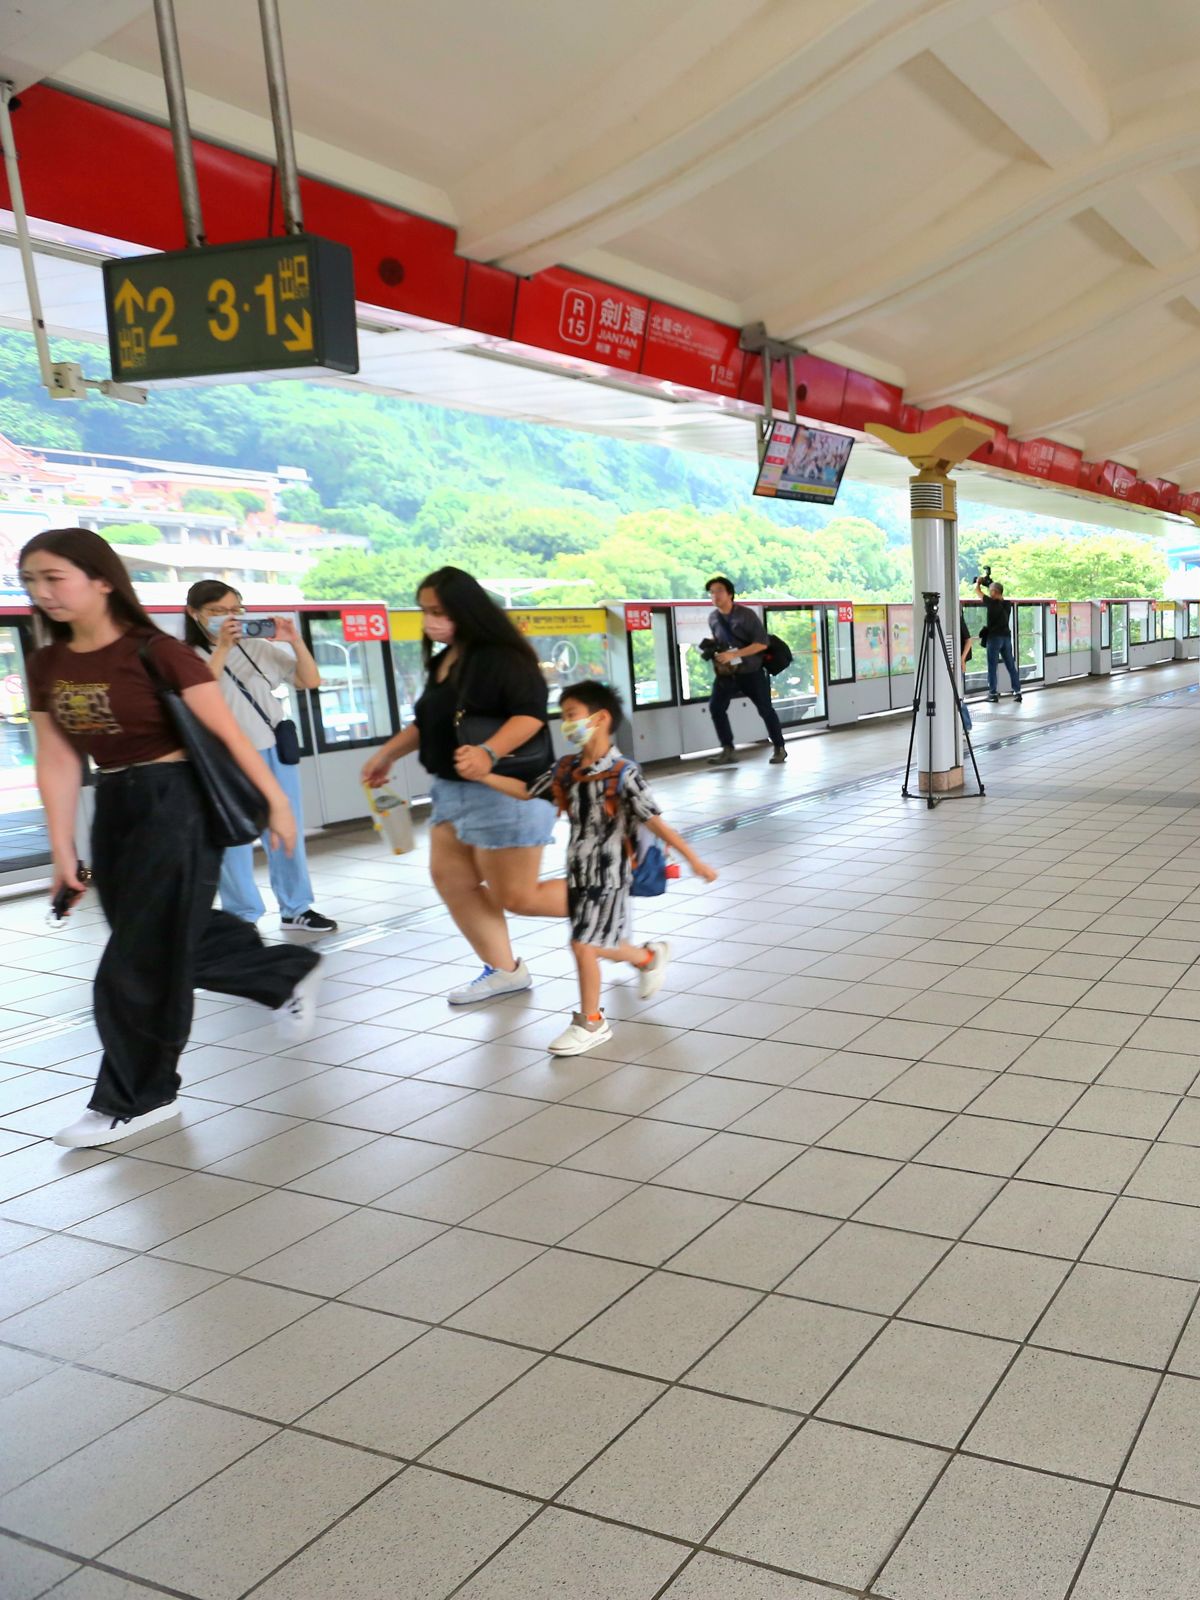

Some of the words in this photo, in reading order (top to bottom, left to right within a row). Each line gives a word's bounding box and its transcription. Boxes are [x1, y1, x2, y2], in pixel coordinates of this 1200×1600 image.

[278, 255, 309, 301] 出口
[147, 286, 178, 349] 2
[573, 298, 585, 317] R
[599, 297, 646, 337] 劍潭
[567, 317, 585, 337] 15
[597, 328, 638, 349] JIANTAN
[118, 326, 146, 369] 出口
[369, 614, 386, 637] 3
[640, 610, 650, 627] 3
